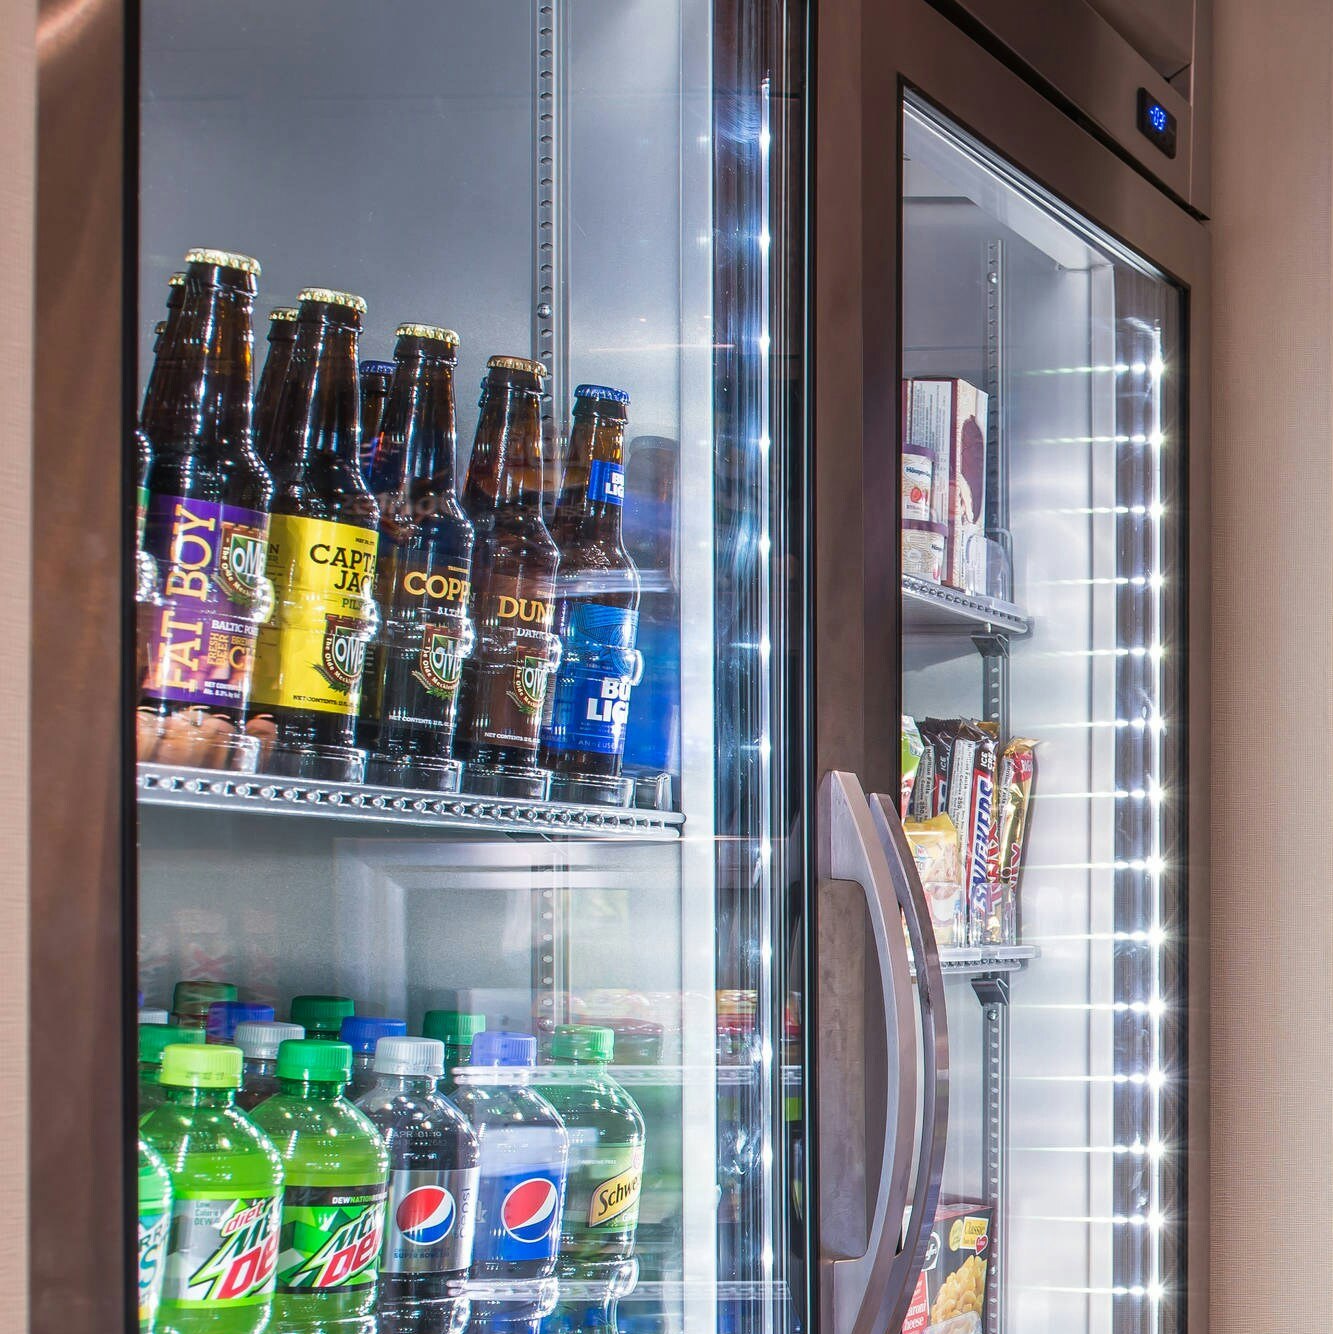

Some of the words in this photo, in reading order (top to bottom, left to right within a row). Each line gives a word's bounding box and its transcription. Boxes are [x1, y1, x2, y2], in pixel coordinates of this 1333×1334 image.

[167, 503, 216, 602] BOY
[211, 619, 243, 633] BALTIC
[156, 609, 203, 692] FAT
[980, 752, 988, 768] ICE
[226, 1203, 265, 1235] diet
